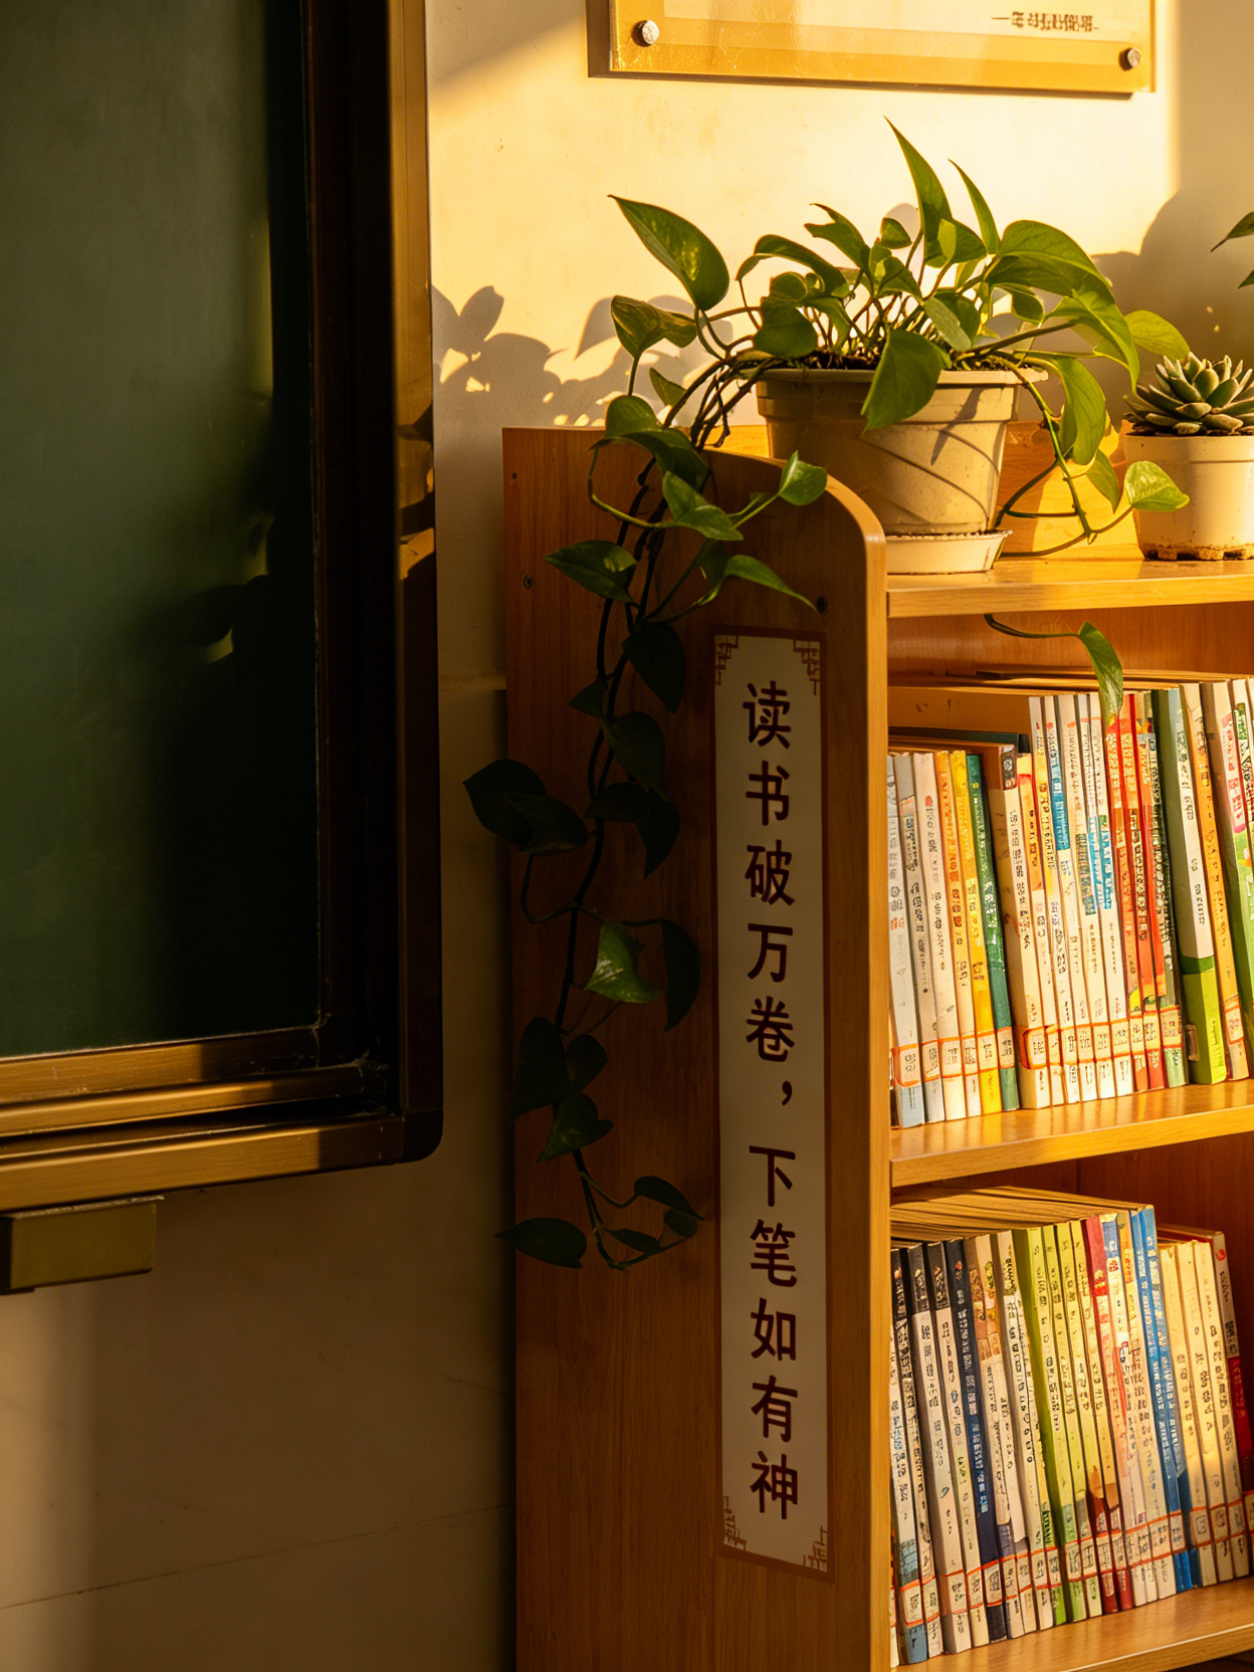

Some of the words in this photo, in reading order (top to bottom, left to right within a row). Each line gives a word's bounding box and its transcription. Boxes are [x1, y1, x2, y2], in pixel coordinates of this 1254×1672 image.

[742, 680, 798, 1520] 读书破万卷，下笔如有神
